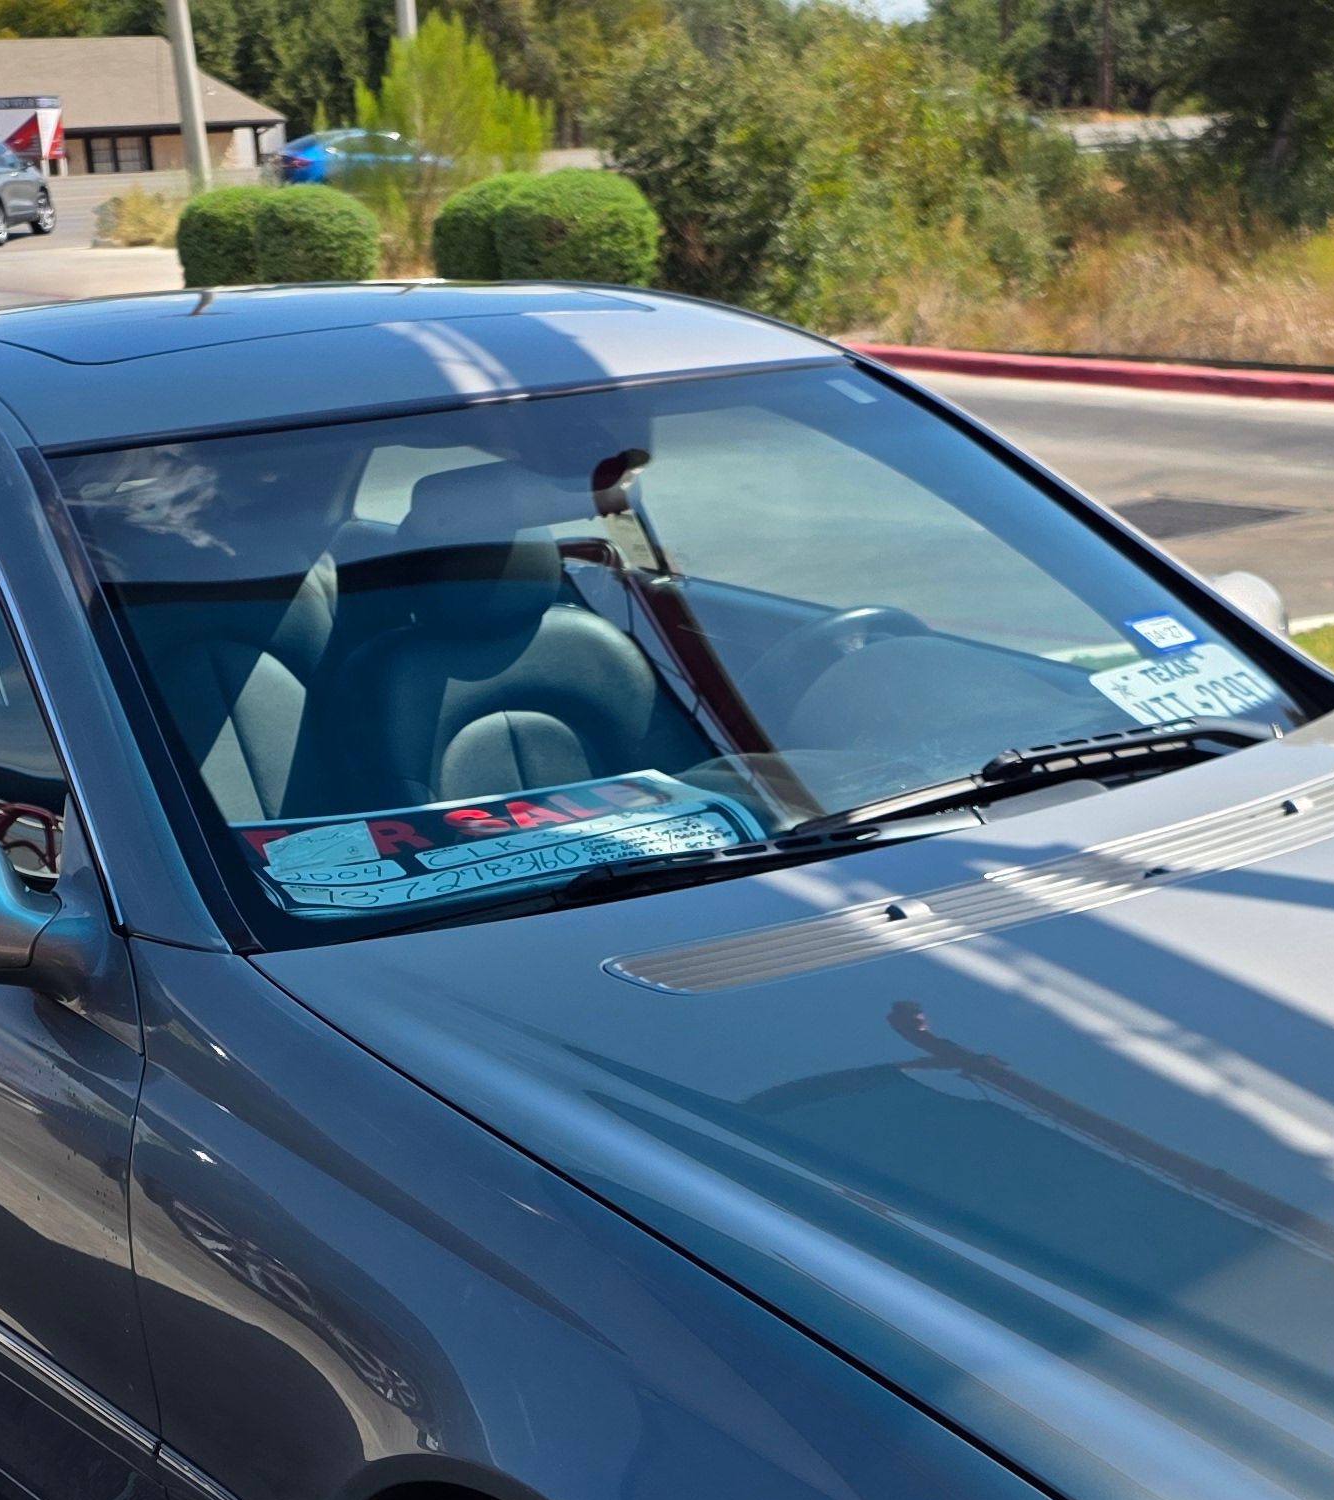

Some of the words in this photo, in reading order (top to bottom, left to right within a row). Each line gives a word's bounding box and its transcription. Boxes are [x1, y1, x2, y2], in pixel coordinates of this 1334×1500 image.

[1139, 657, 1199, 685] TEXAS
[241, 820, 433, 857] FR
[443, 782, 665, 836] SALE
[427, 840, 524, 867] CLK
